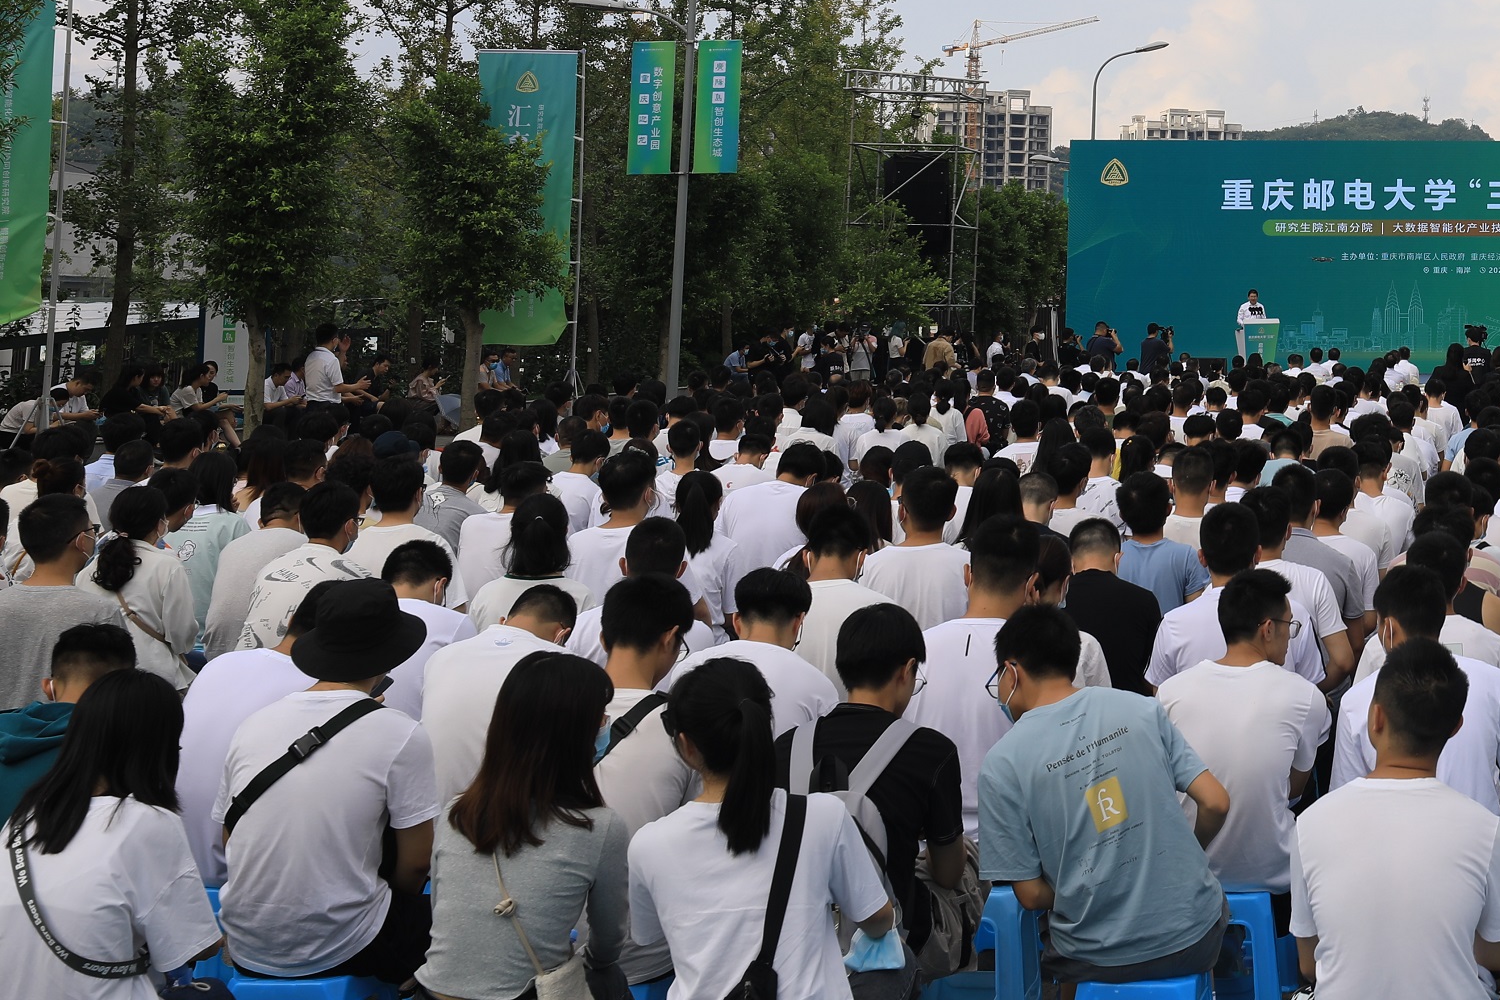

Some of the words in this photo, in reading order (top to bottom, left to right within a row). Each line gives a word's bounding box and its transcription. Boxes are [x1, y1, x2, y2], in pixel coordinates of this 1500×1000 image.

[650, 67, 663, 150] 数字创意产业园
[1275, 222, 1374, 234] 研究生院江南分院
[1046, 753, 1075, 773] Pensée
[1076, 748, 1086, 758] de
[15, 848, 25, 870] Bare
[18, 869, 28, 888] We
[26, 899, 43, 926] Bears
[40, 925, 56, 946] Bare
[54, 944, 69, 960] We
[82, 962, 109, 976] Bears
